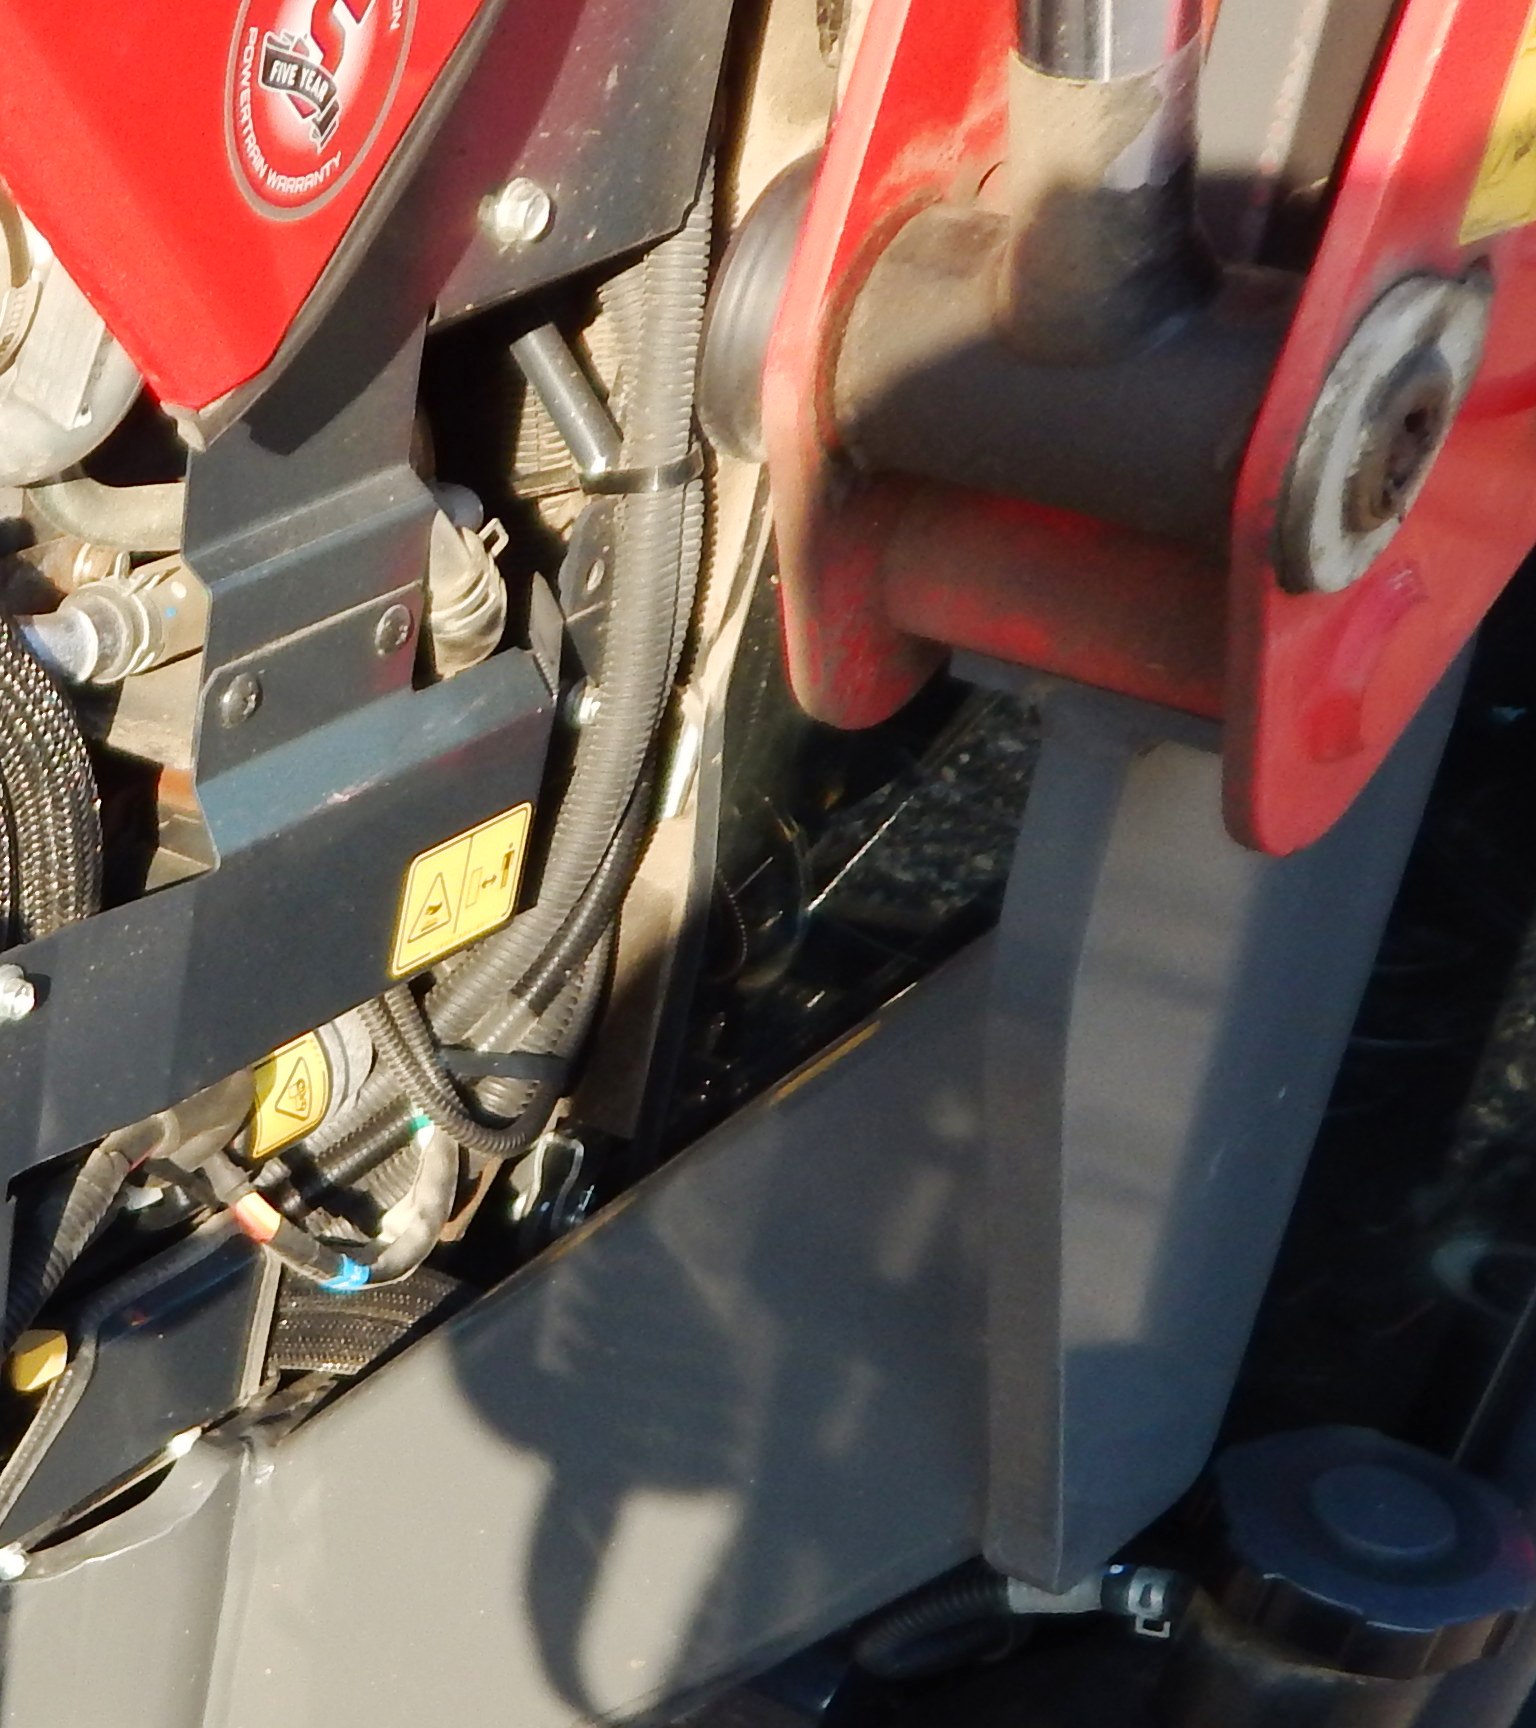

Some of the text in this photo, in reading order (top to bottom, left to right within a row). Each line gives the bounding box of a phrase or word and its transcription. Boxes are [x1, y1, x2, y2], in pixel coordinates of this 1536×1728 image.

[239, 27, 341, 194] POWERTRAIN WARRANTY
[269, 59, 329, 101] FIVE YEAR
